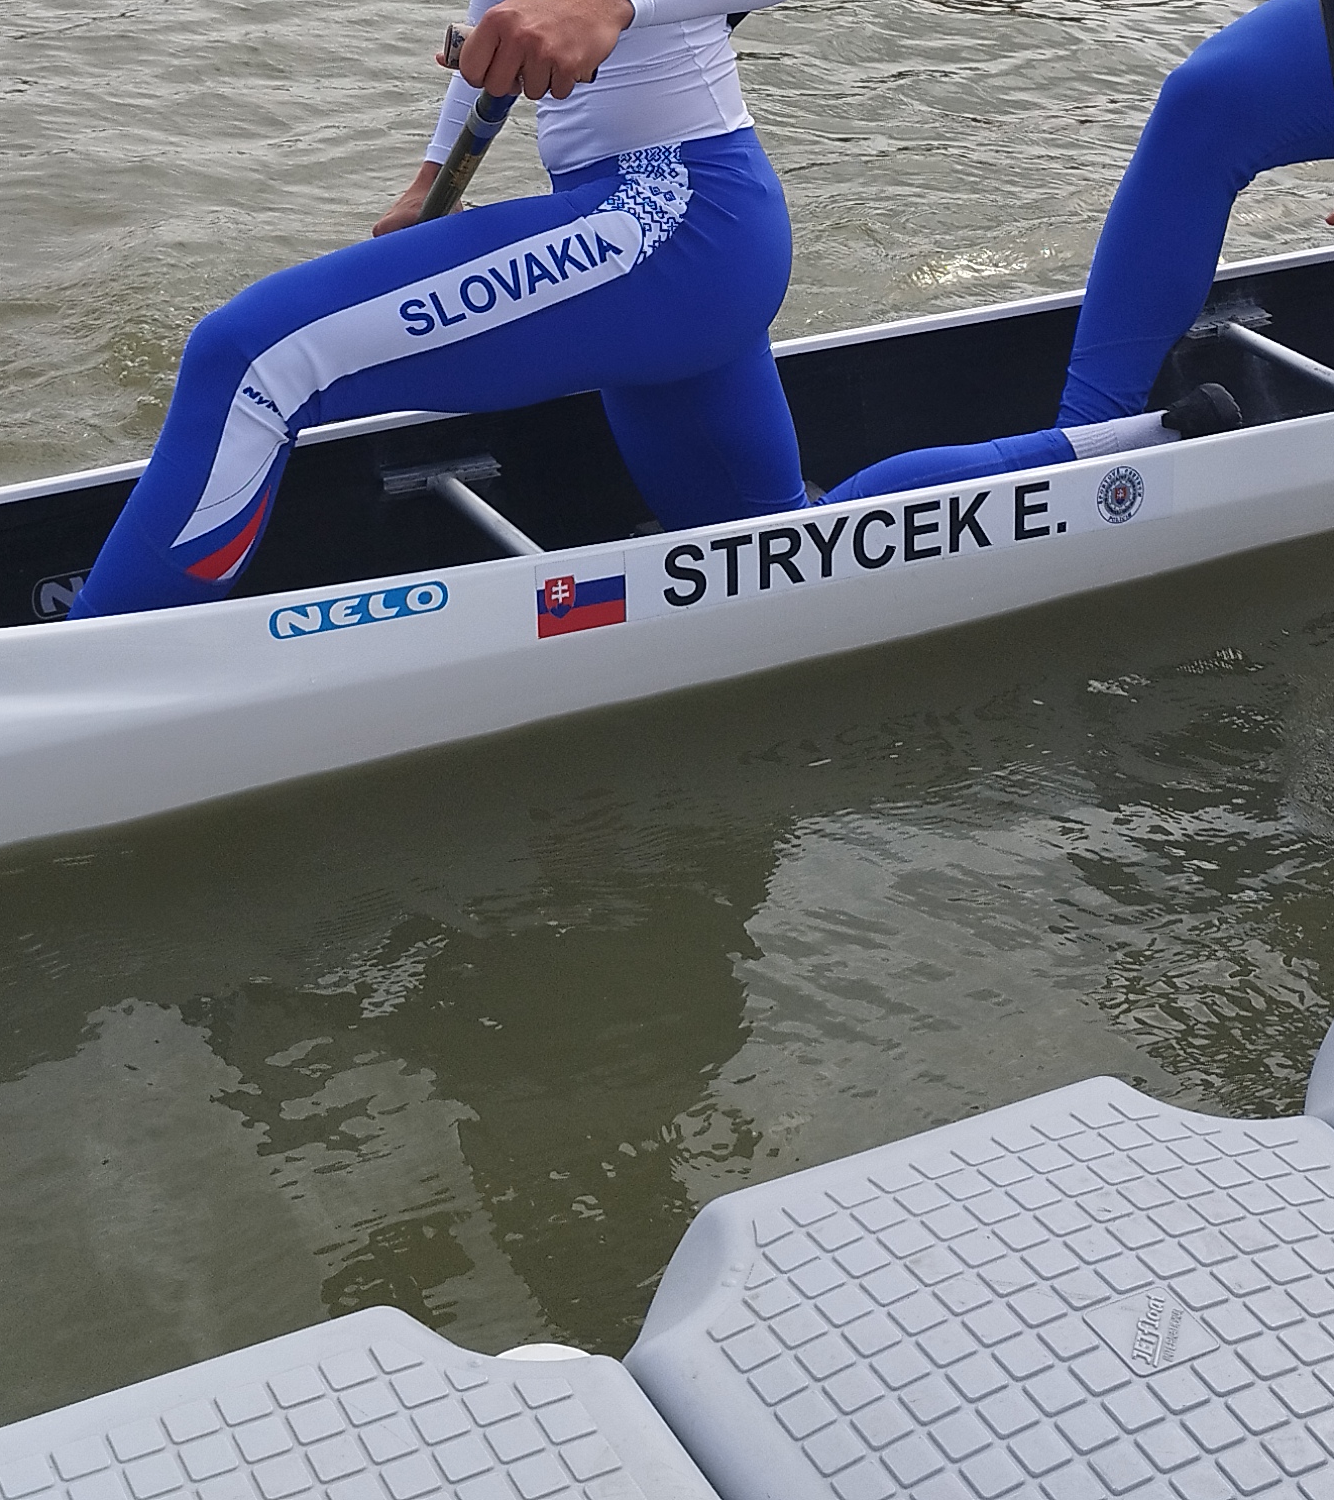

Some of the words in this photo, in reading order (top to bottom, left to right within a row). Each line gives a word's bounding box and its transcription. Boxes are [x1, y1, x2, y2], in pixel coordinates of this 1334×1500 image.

[398, 231, 624, 337] SLOVAKIA
[663, 491, 992, 607] STRYCEK
[1014, 481, 1068, 541] E.
[275, 586, 443, 638] NELO
